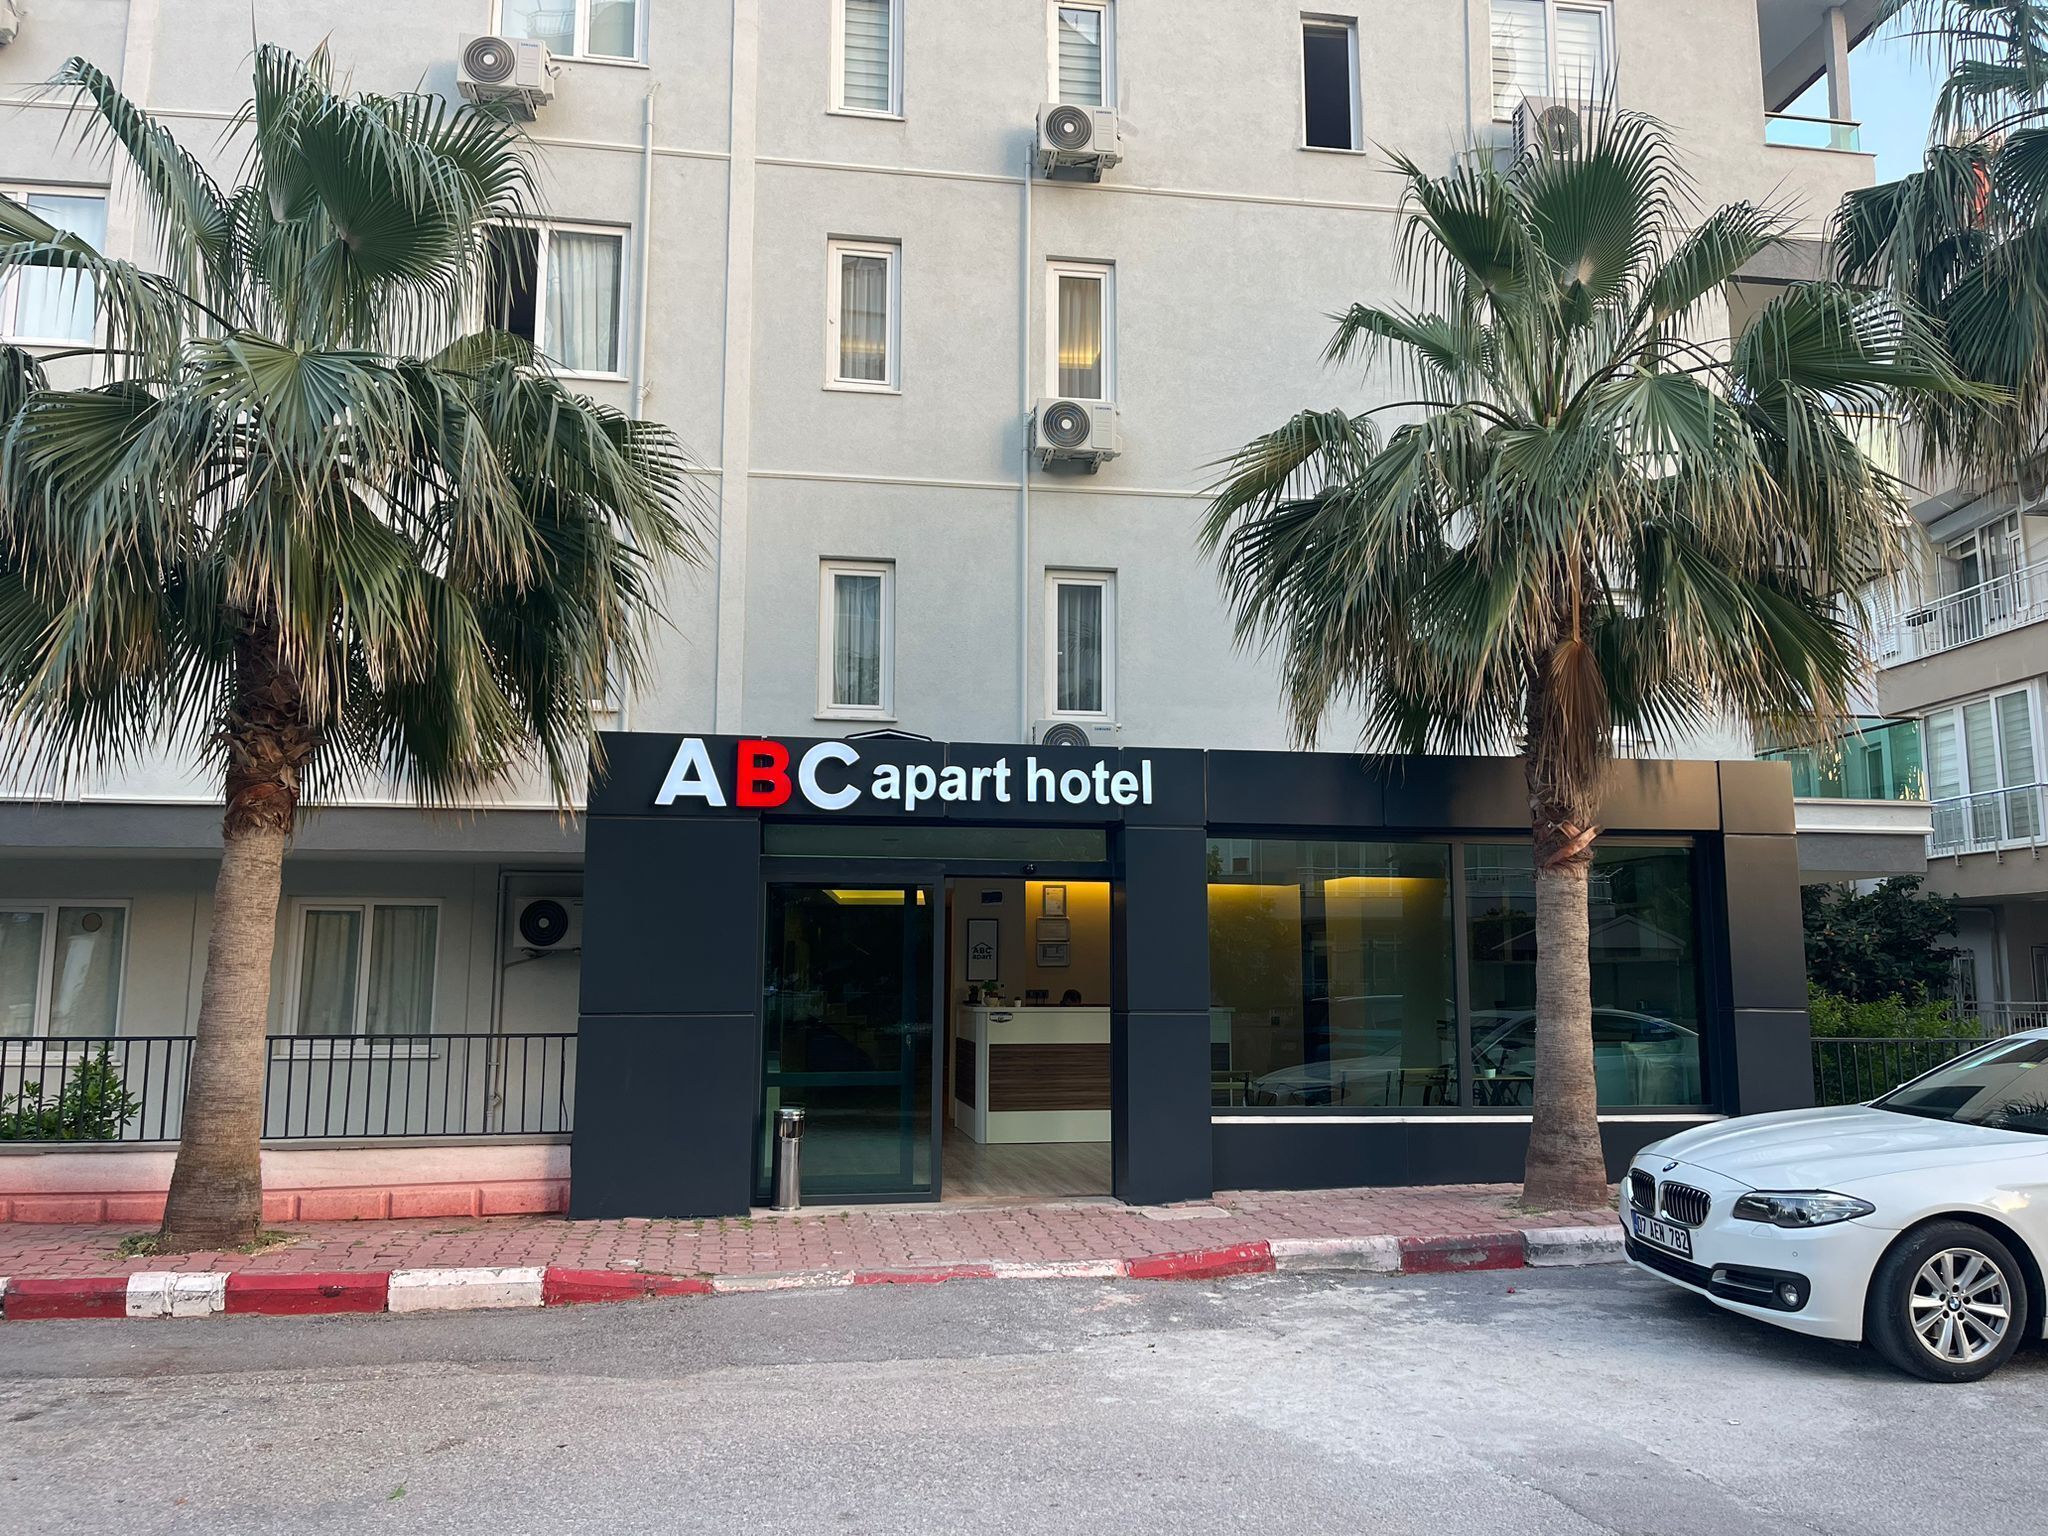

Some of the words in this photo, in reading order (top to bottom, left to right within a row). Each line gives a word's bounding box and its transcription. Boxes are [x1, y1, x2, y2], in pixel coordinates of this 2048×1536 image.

[654, 737, 861, 810] ABC
[871, 757, 1012, 811] apart
[1026, 756, 1154, 806] hotel
[1637, 1215, 1647, 1235] 07
[1649, 1219, 1666, 1243] AEN
[1668, 1226, 1690, 1251] 782
